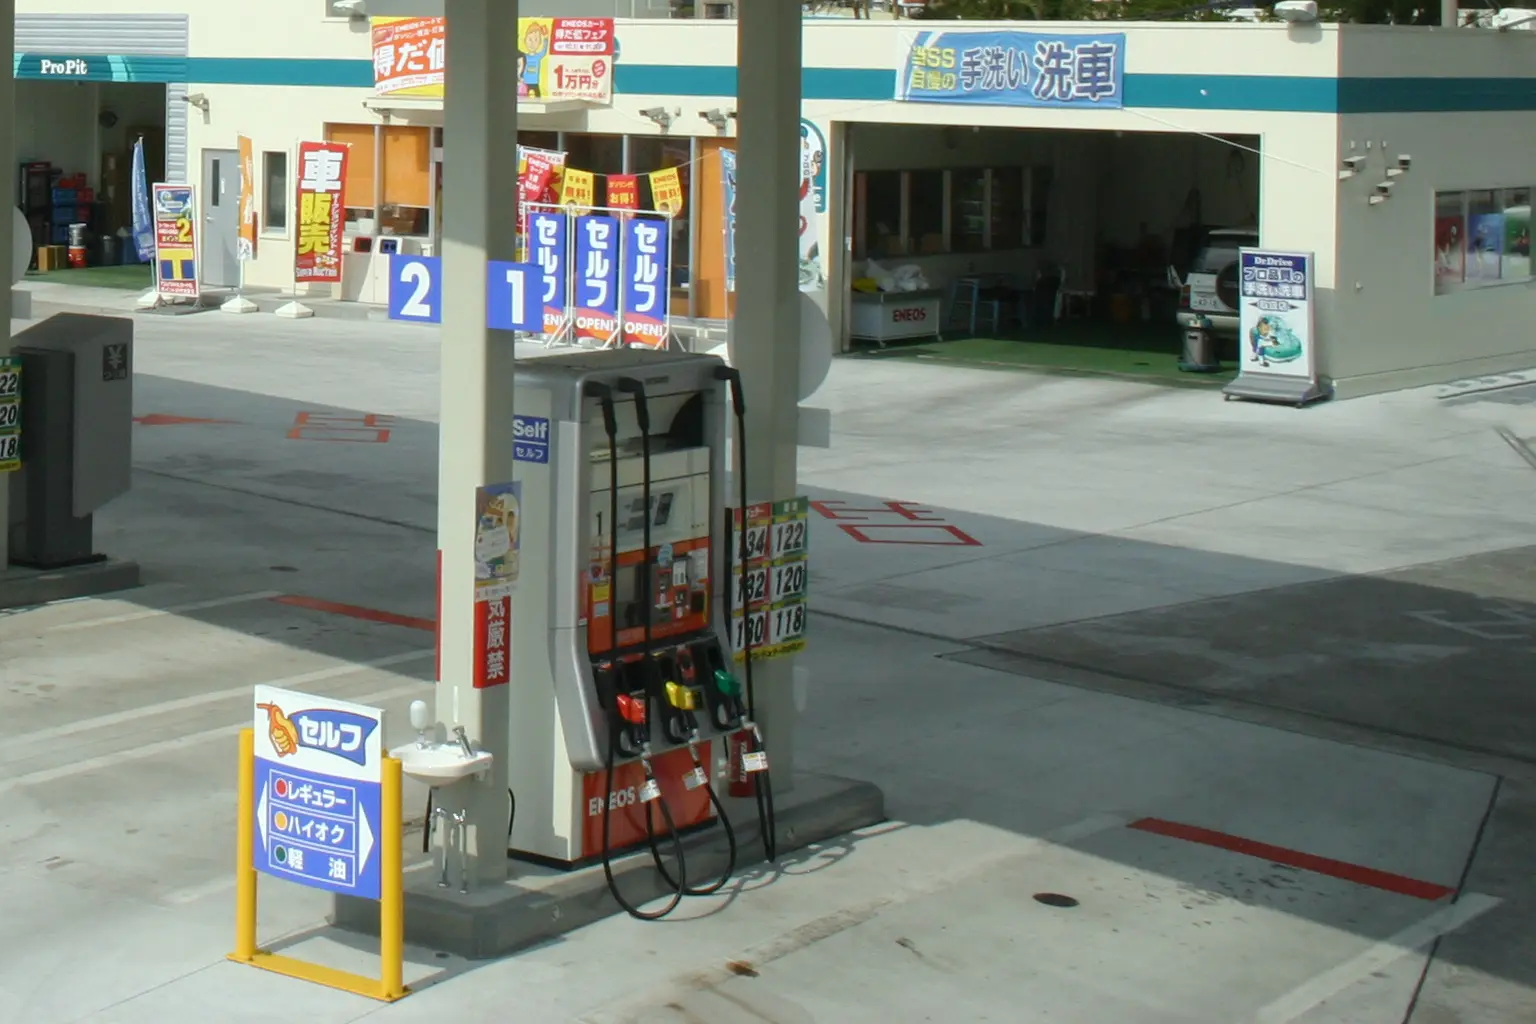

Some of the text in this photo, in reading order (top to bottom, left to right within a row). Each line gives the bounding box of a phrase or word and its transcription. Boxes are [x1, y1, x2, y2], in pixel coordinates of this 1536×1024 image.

[536, 216, 557, 303] セルフ
[586, 219, 609, 308] セルフ
[634, 223, 658, 313] セルフ
[400, 262, 431, 317] 2
[506, 269, 524, 325] 1
[577, 316, 615, 332] OPEN!
[625, 322, 664, 337] OPEN!
[893, 308, 927, 323] ENEOS
[513, 419, 548, 439] Self
[516, 446, 544, 460] セルフ
[777, 522, 804, 552] 122
[776, 565, 804, 595] 120
[776, 606, 803, 636] 118
[298, 715, 362, 752] セルフ
[288, 780, 347, 809] レギュラー
[288, 815, 345, 844] ハイオク
